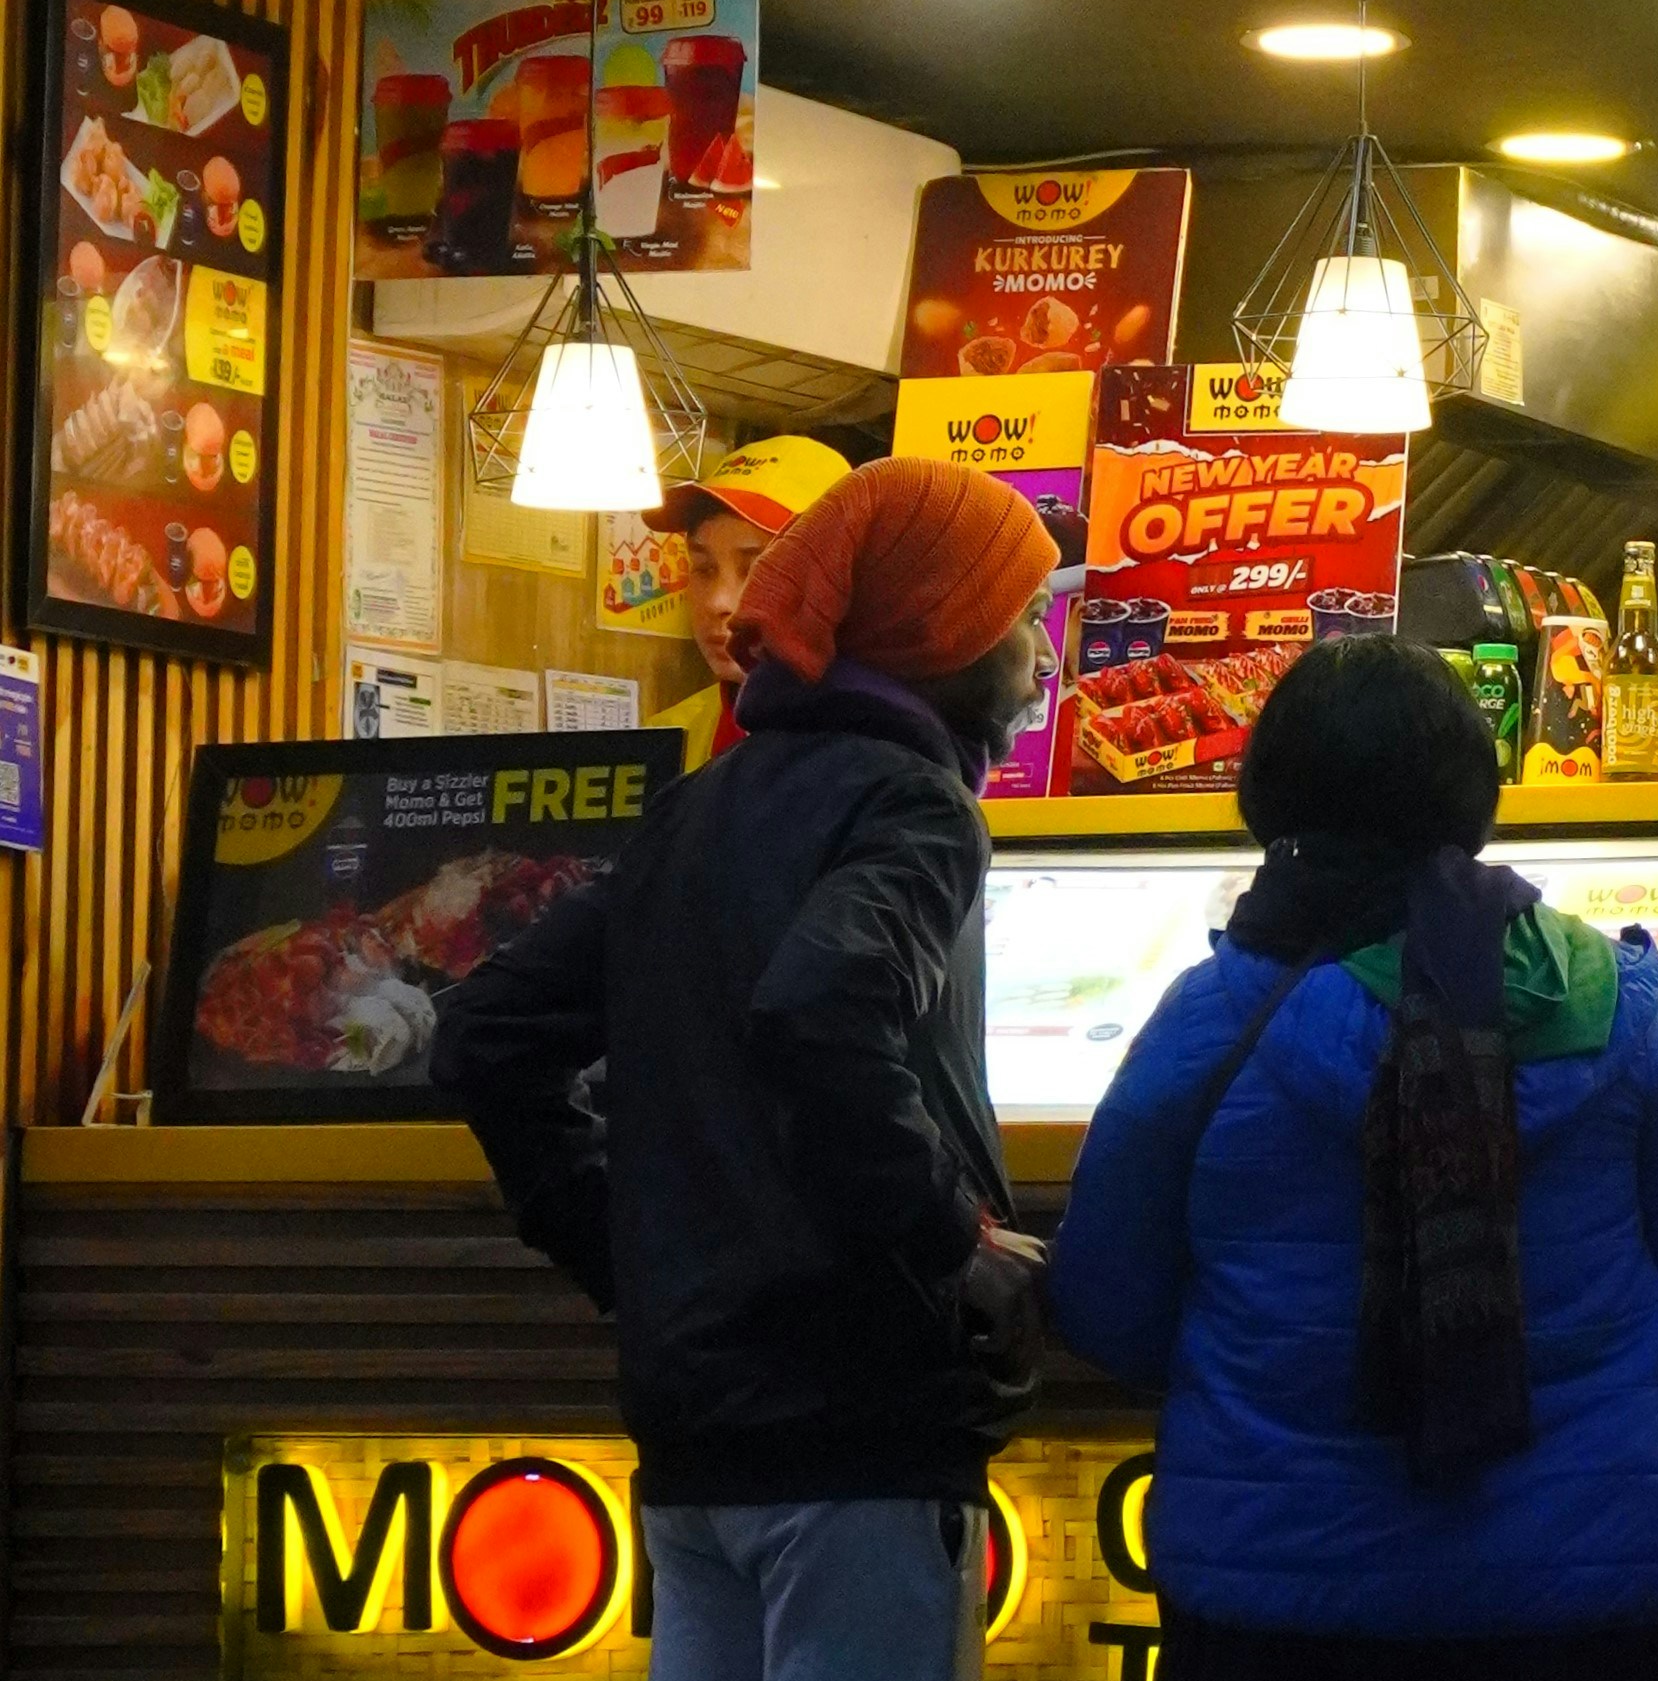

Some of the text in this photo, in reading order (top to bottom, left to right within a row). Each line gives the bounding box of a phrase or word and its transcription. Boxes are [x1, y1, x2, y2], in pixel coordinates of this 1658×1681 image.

[1014, 179, 1092, 207] WOW!
[1014, 234, 1084, 245] INTRODUCING
[974, 243, 1125, 273] KURKUREY
[1004, 272, 1085, 294] MOMO
[947, 413, 1036, 445] WOW!
[1141, 451, 1359, 496] NEW YEAR
[1128, 487, 1367, 555] OFFER
[1190, 585, 1216, 595] ONLY
[1228, 559, 1308, 592] 299/-
[1167, 623, 1220, 637] MOMO
[1256, 623, 1309, 637] MOMO
[386, 773, 489, 794] Buy a Sizzler
[491, 764, 647, 824] FREE
[385, 791, 484, 810] Momo & Get
[383, 809, 487, 829] 400ml Pepsi
